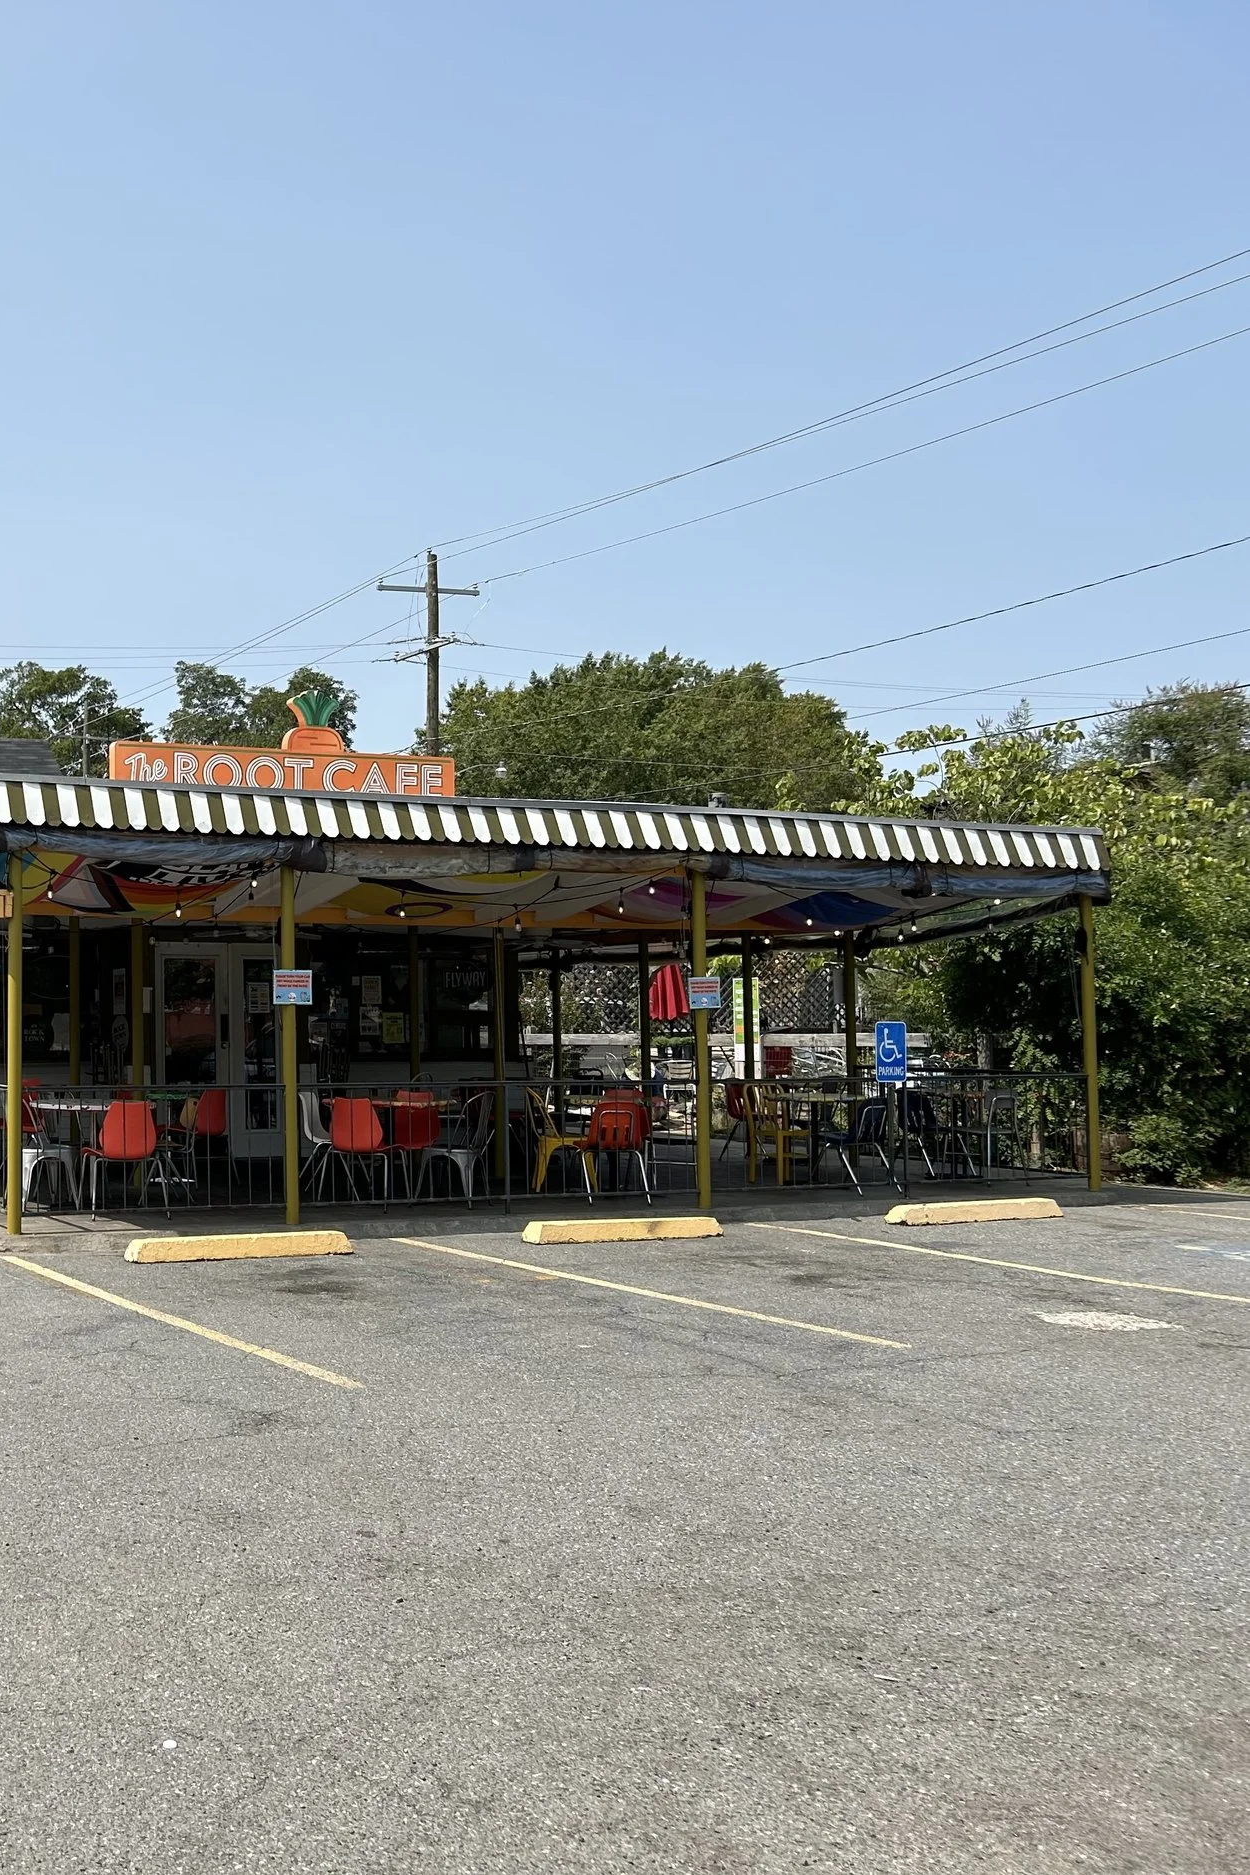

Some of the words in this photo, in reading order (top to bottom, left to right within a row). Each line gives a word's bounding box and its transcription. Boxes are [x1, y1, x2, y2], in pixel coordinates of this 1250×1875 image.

[124, 752, 168, 782] The
[173, 751, 314, 790] ROOT
[322, 758, 443, 797] CAFE
[445, 970, 486, 988] FLYWAY
[878, 1066, 904, 1077] PARKING
